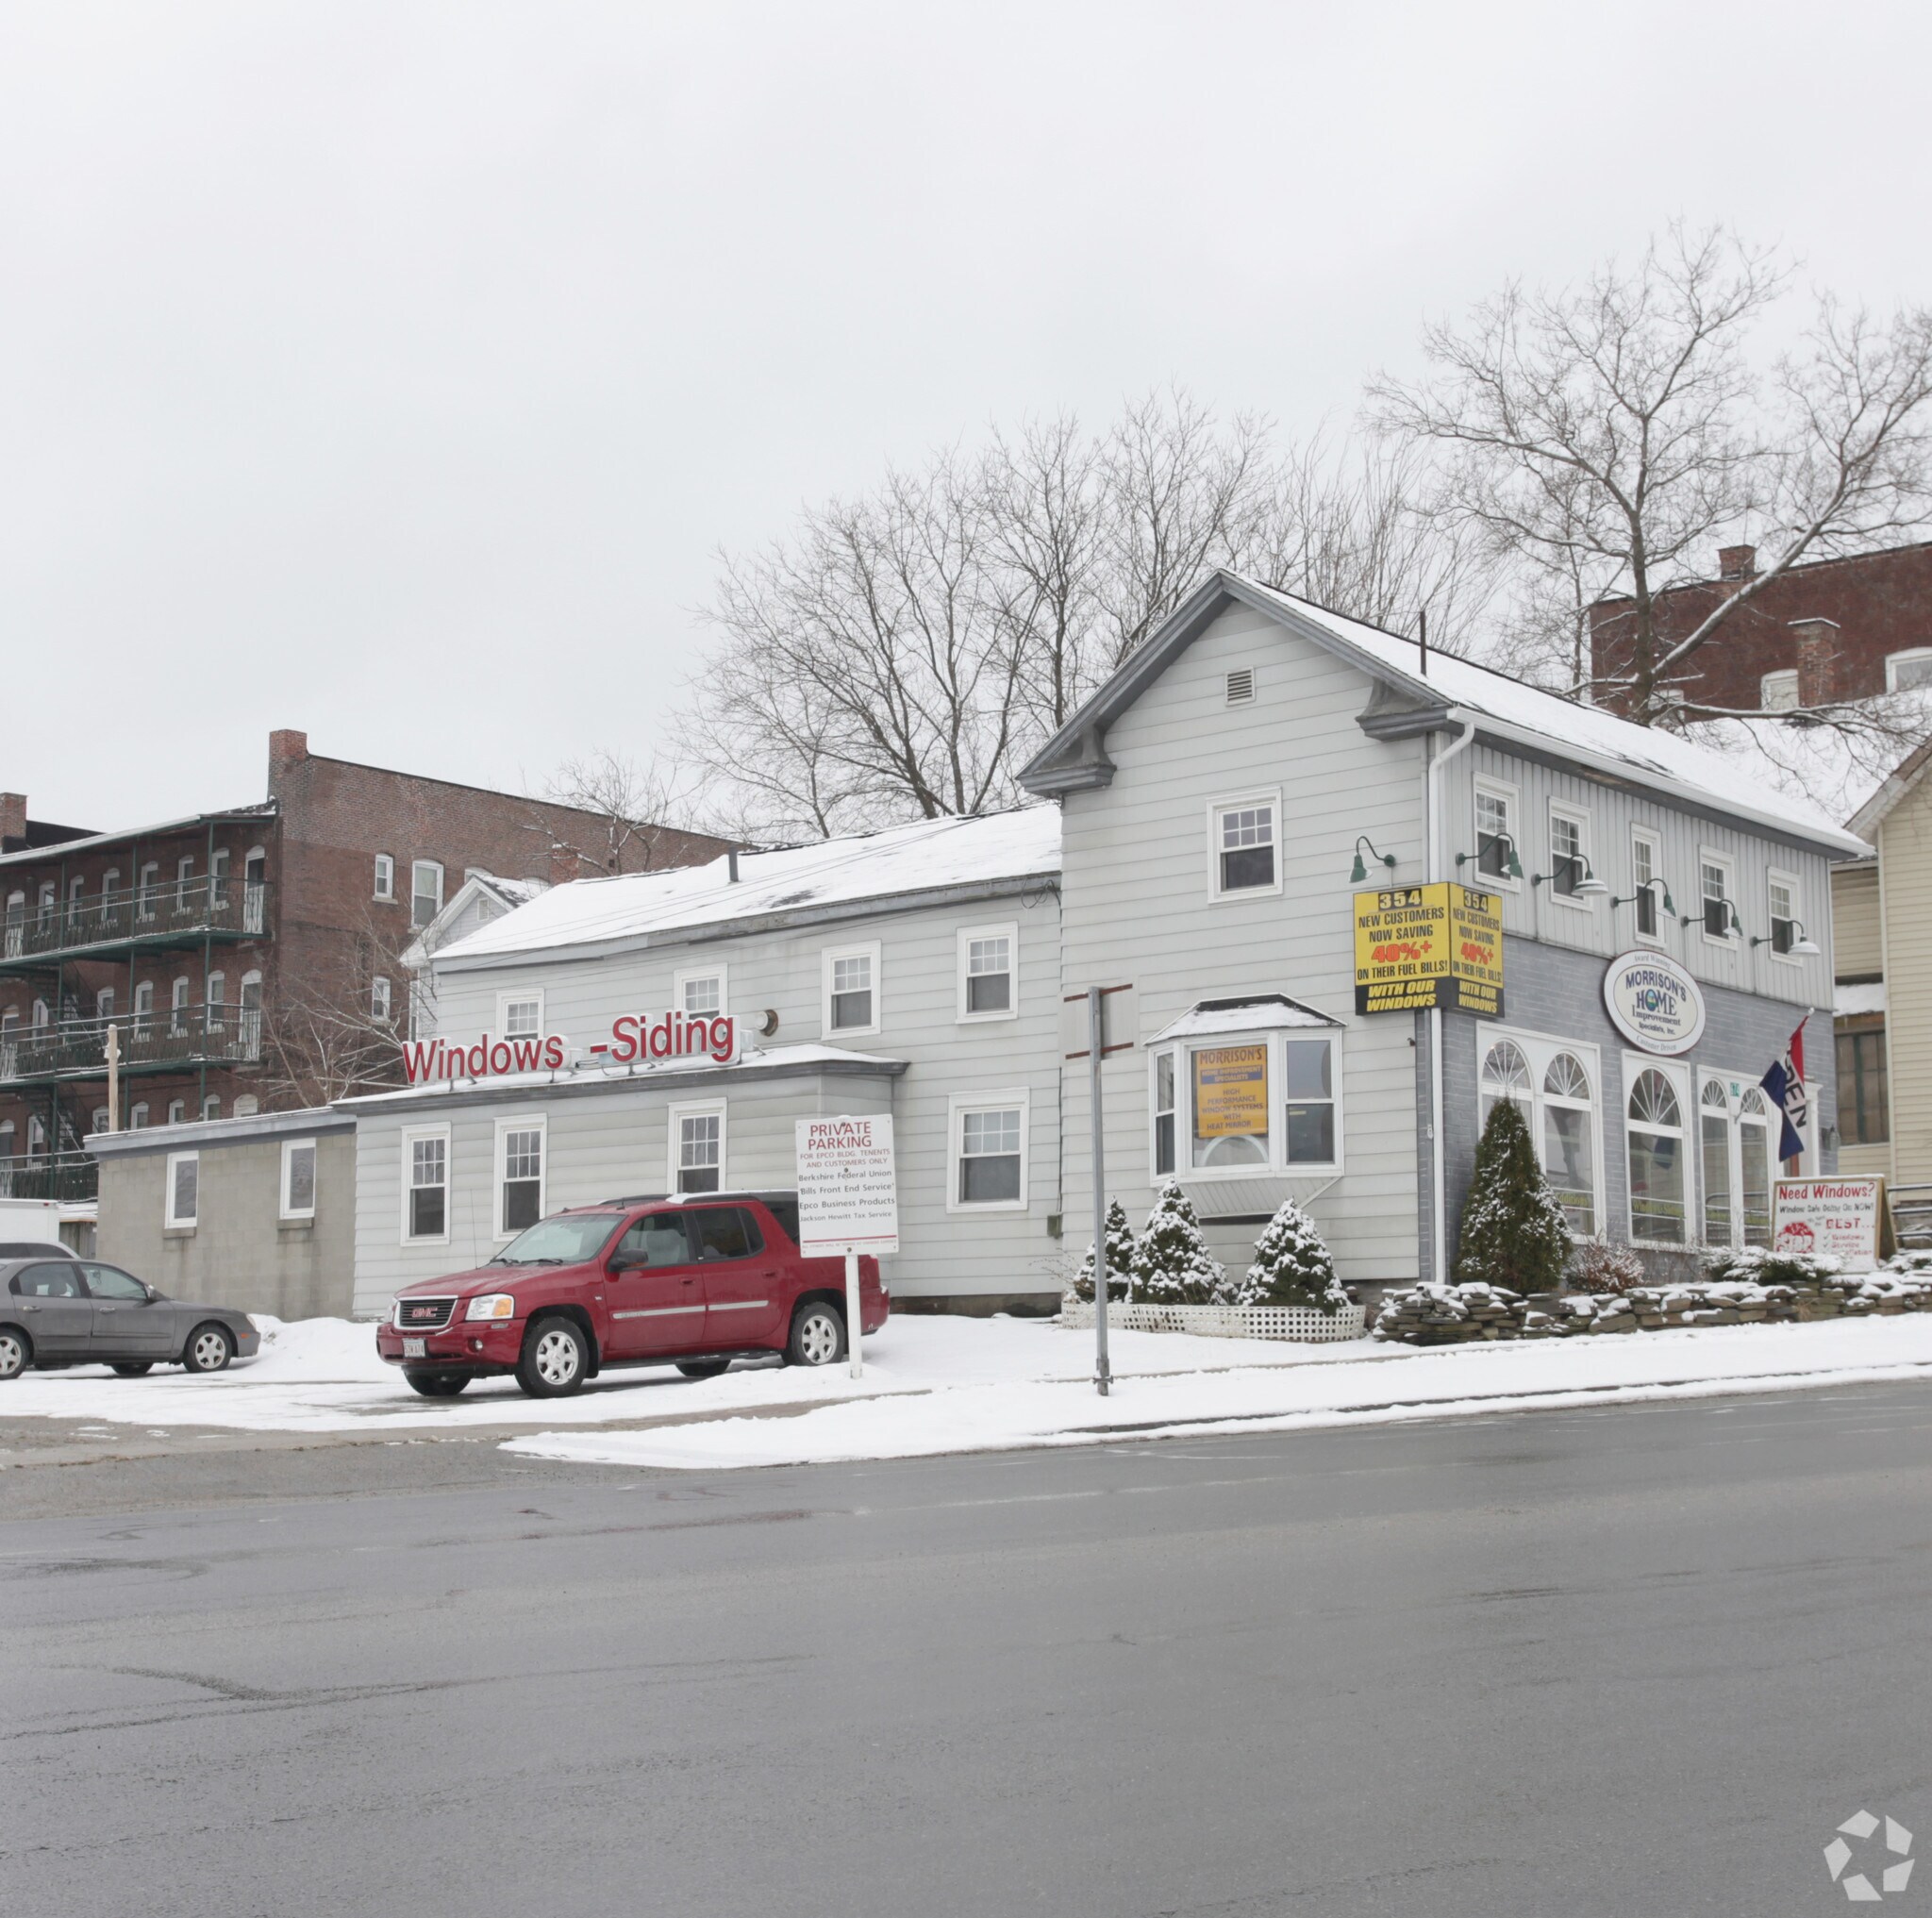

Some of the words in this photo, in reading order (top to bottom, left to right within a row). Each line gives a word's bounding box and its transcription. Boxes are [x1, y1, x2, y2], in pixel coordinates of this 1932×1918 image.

[1379, 891, 1422, 909] 354
[1464, 891, 1489, 911] 354
[1358, 915, 1380, 928] NEW
[1384, 907, 1444, 926] CUSTOMERS
[1453, 908, 1466, 922] NEW
[1467, 912, 1500, 932] CUSTOMERS
[1369, 929, 1392, 942] NOW
[1396, 925, 1433, 941] SAVING
[1458, 926, 1473, 940] NOW
[1474, 930, 1494, 945] SAVING
[1357, 968, 1369, 980] ON
[1372, 965, 1395, 978] THEIR
[1398, 962, 1418, 976] FUEL
[1421, 959, 1448, 974] BILLS!
[1453, 960, 1460, 973] ON
[1461, 962, 1474, 976] THEIR
[1475, 965, 1487, 978] FUEL
[1368, 983, 1405, 998] WITH
[1407, 979, 1436, 993] OUR
[1458, 980, 1479, 995] WITH
[1480, 986, 1497, 1000] OUR
[1625, 970, 1687, 1002] MORRISON'S
[1366, 993, 1437, 1012] WINDOWS
[1458, 995, 1498, 1014] WINDOWS
[1636, 989, 1677, 1016] HOME
[1632, 1005, 1681, 1026] Improvement
[402, 1033, 564, 1084] Windows
[1200, 1048, 1262, 1065] MORRISON'S
[1202, 1105, 1231, 1113] WINDOW
[1233, 1103, 1263, 1111] SYSTEMS
[1208, 1095, 1257, 1105] PERFORMANCE
[810, 1122, 872, 1137] PRIVATE
[808, 1135, 872, 1150] PARKING
[860, 1148, 891, 1157] TENENTS
[824, 1159, 866, 1168] CUSTOMERS
[799, 1173, 834, 1181] Berkshire
[838, 1170, 866, 1179] Federal
[844, 1184, 859, 1192] End
[1779, 1185, 1807, 1200] Need
[1813, 1182, 1875, 1198] Windows?
[799, 1202, 818, 1210] Epco
[822, 1199, 856, 1208] Business
[859, 1197, 895, 1206] Products
[411, 1308, 438, 1318] GMC
